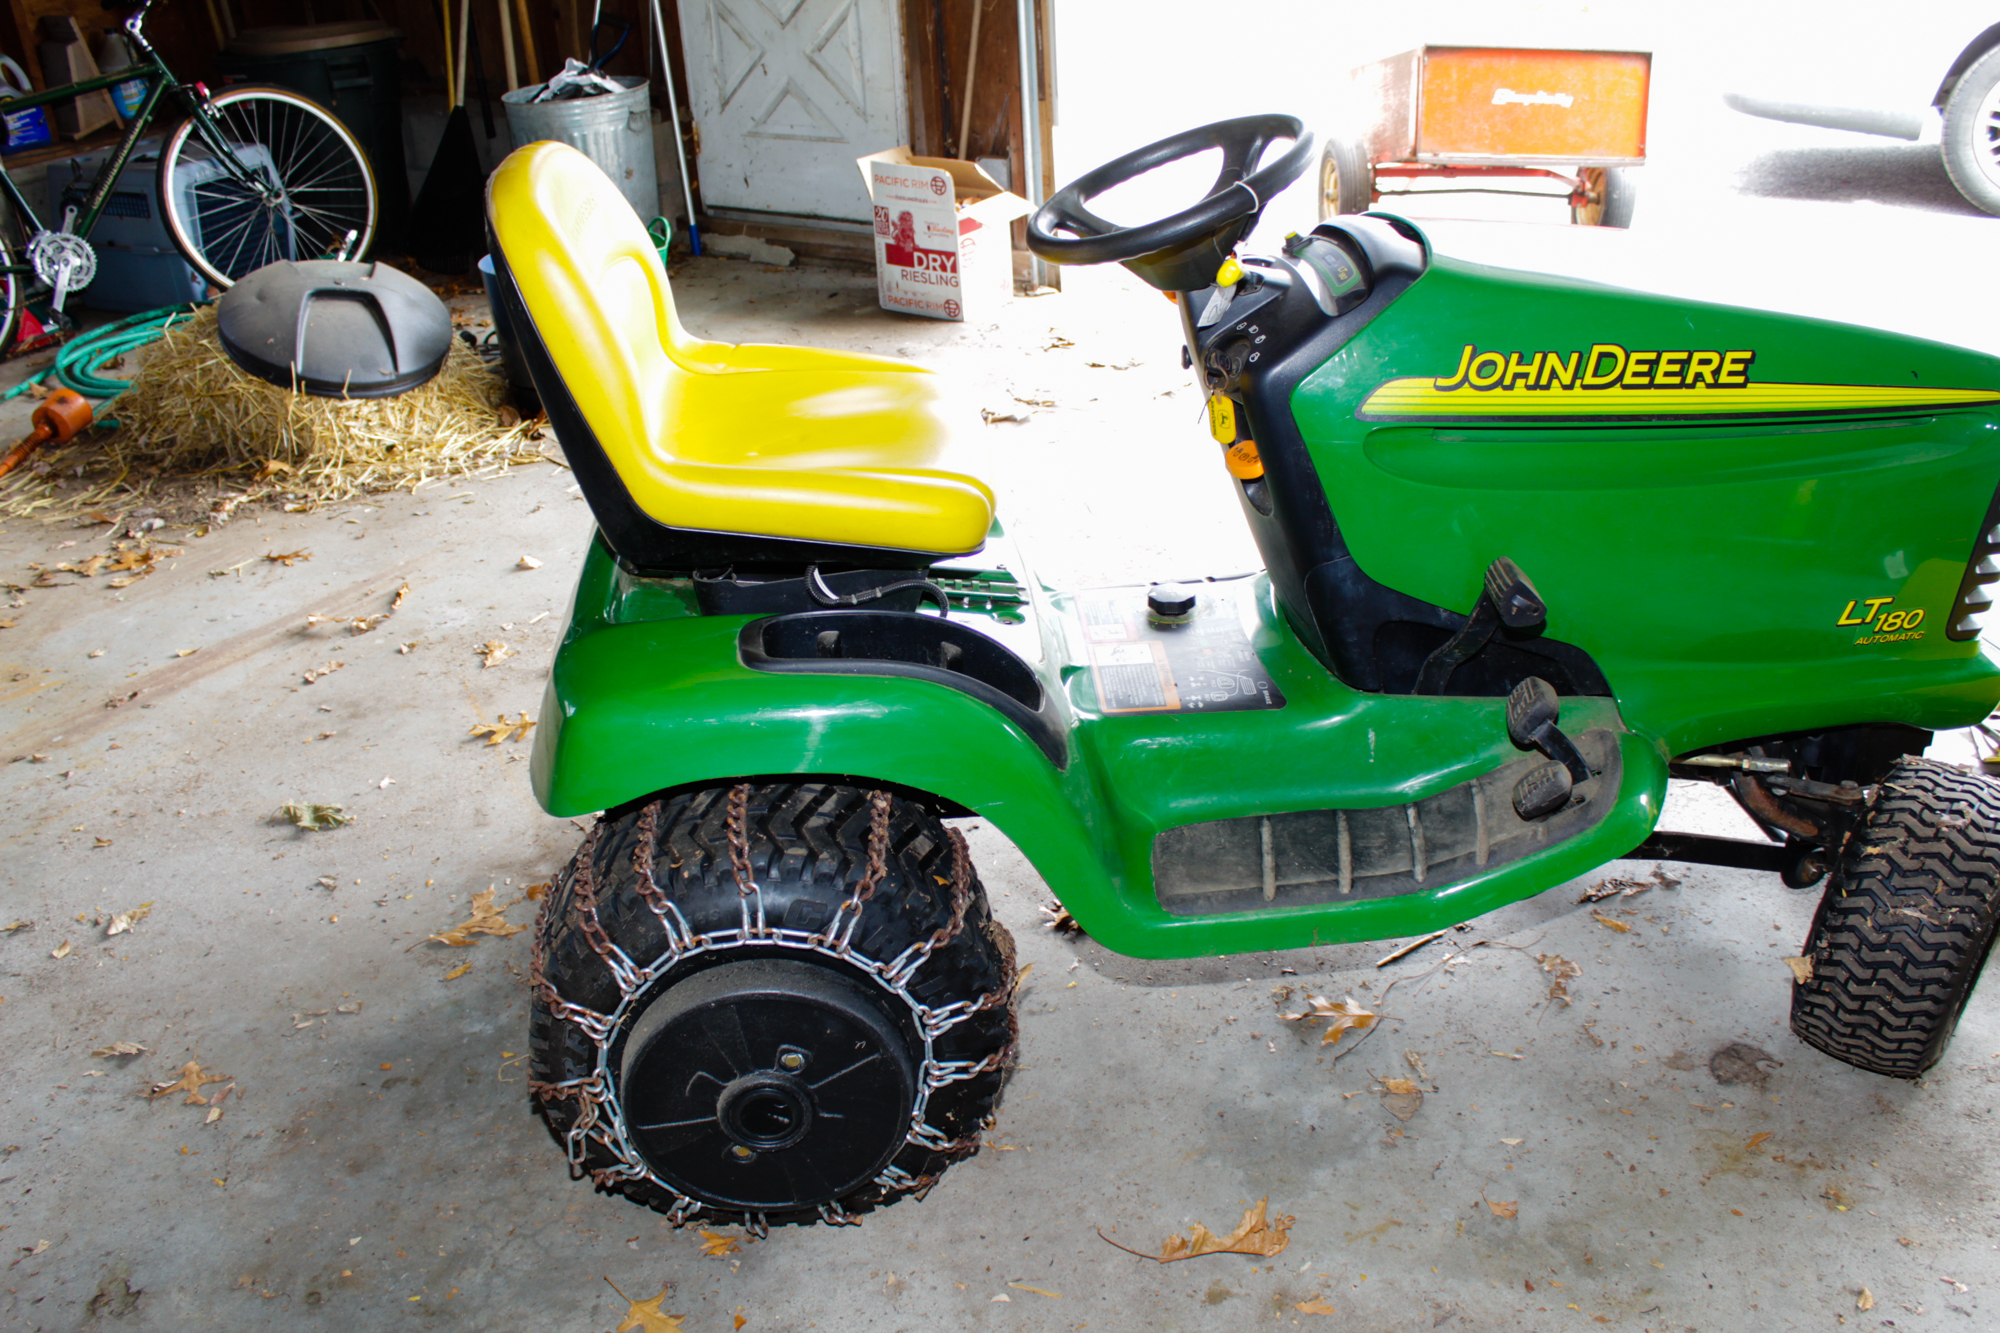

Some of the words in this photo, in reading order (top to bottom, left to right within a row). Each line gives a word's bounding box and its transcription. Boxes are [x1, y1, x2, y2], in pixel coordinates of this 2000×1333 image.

[874, 174, 910, 188] PACIFIC
[911, 179, 929, 190] RIM
[913, 251, 955, 273] DRY
[901, 269, 959, 287] RIESLING
[888, 295, 925, 310] PACIFIC
[926, 301, 944, 312] RIM
[1434, 343, 1583, 392] JOHN
[1580, 343, 1756, 390] DEERE
[1853, 630, 1926, 646] AUTOMATIC
